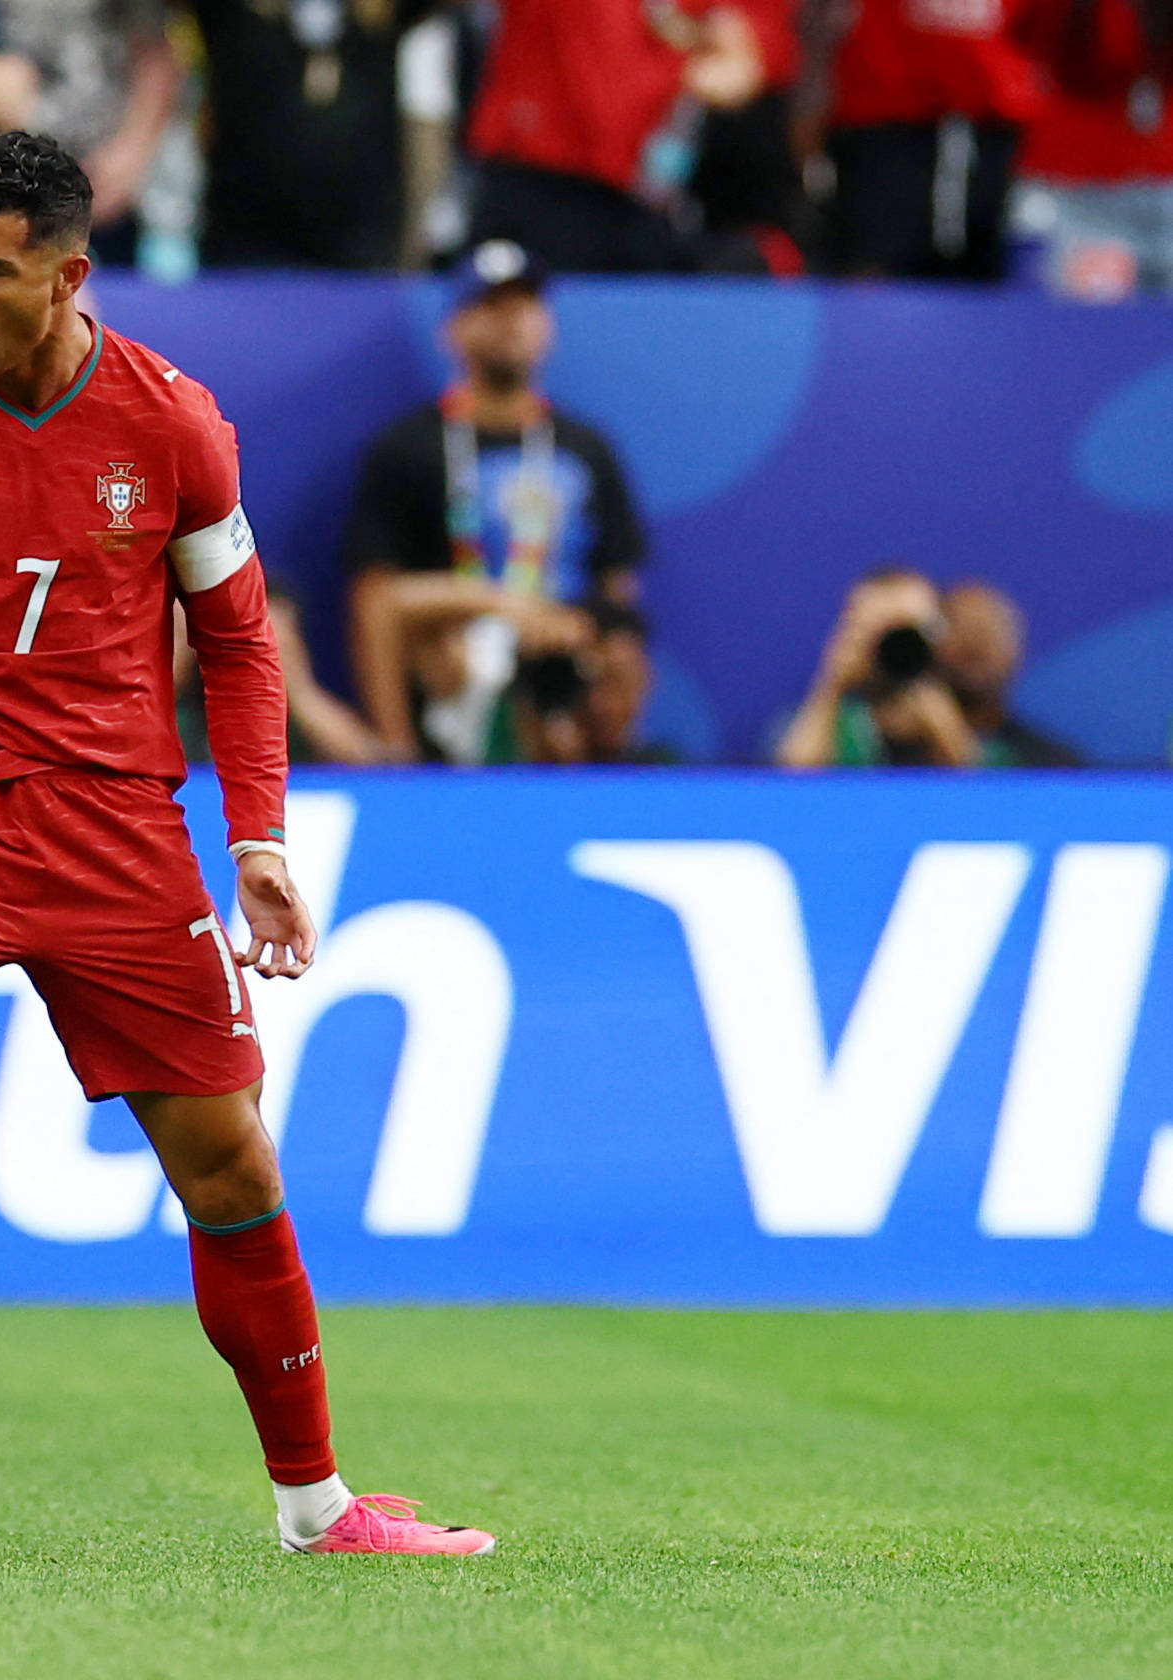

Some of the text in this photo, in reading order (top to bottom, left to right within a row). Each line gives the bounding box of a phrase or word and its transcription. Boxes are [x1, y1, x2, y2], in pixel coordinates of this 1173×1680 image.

[13, 557, 61, 655] 7
[188, 910, 243, 1016] 7
[565, 837, 1173, 1241] VI
